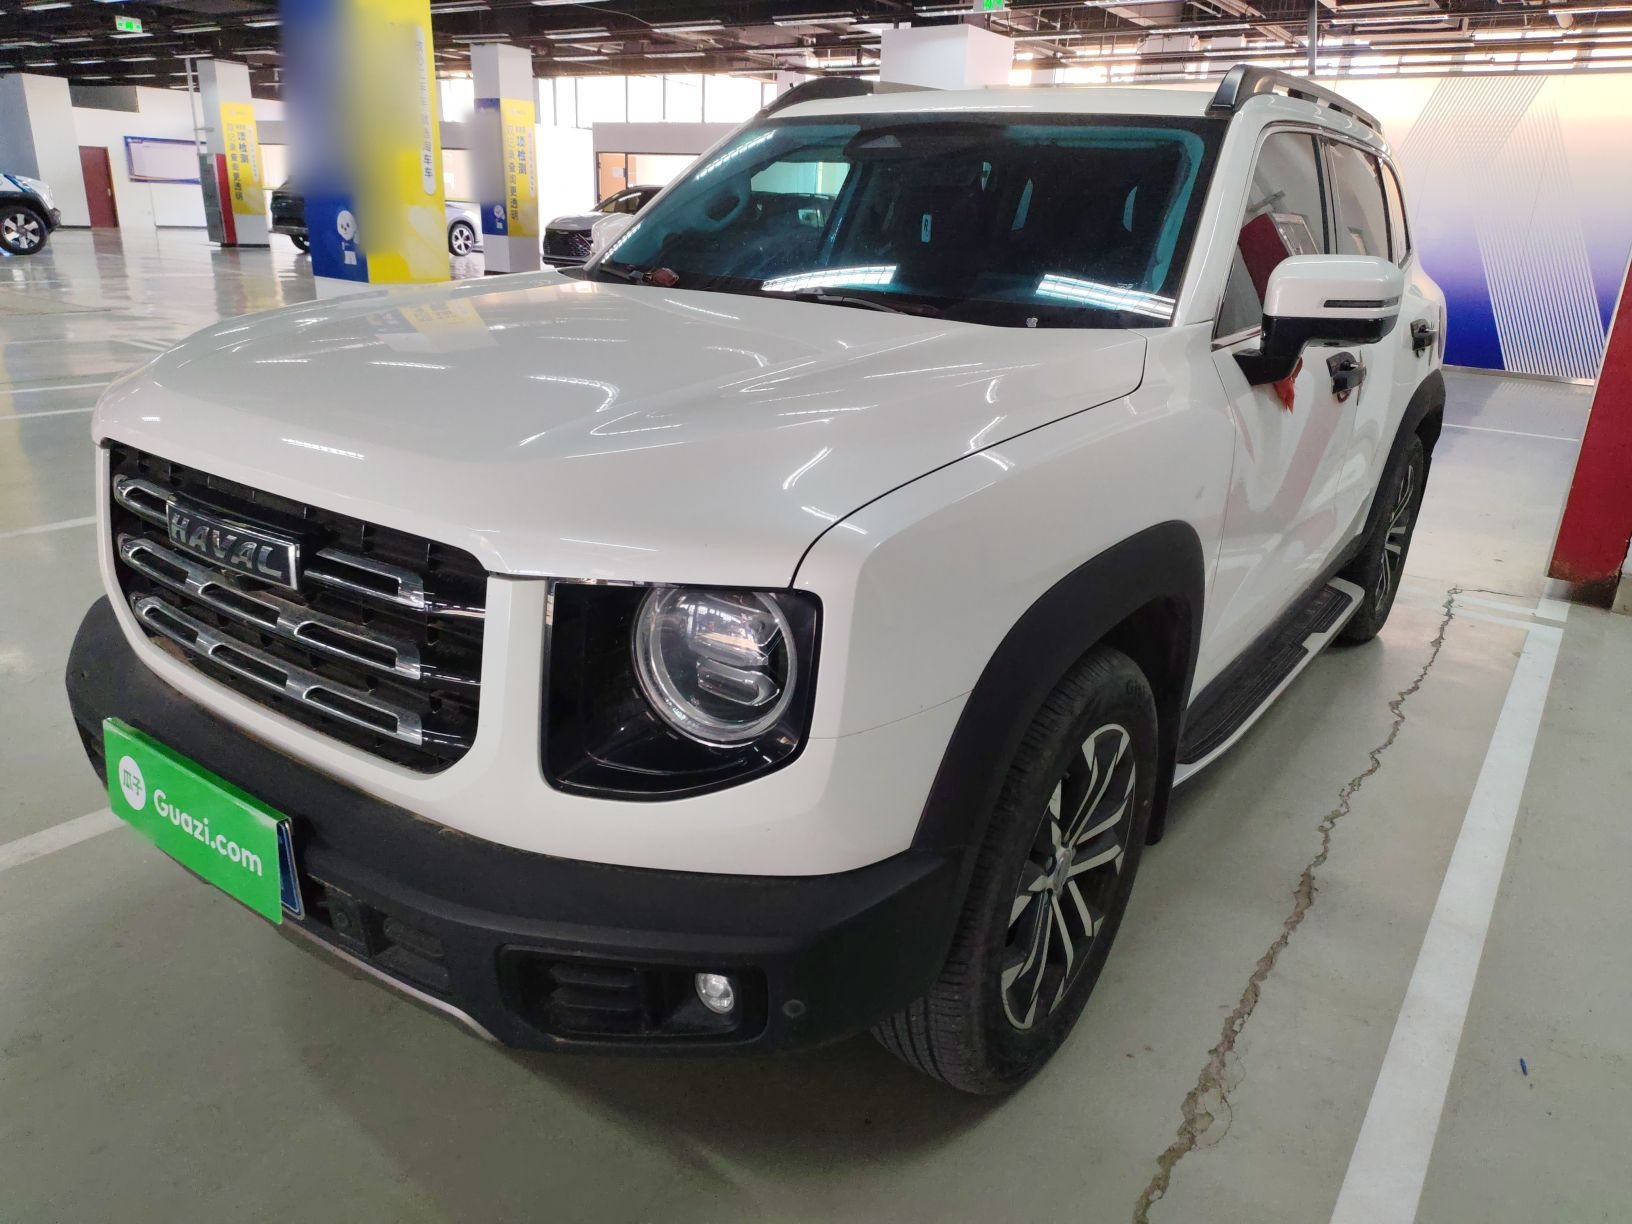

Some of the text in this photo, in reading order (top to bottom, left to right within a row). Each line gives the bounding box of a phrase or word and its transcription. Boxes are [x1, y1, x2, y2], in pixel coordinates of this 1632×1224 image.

[170, 513, 283, 579] HAVAL
[122, 768, 143, 797] 瓜子
[153, 788, 263, 877] Guazi.com
